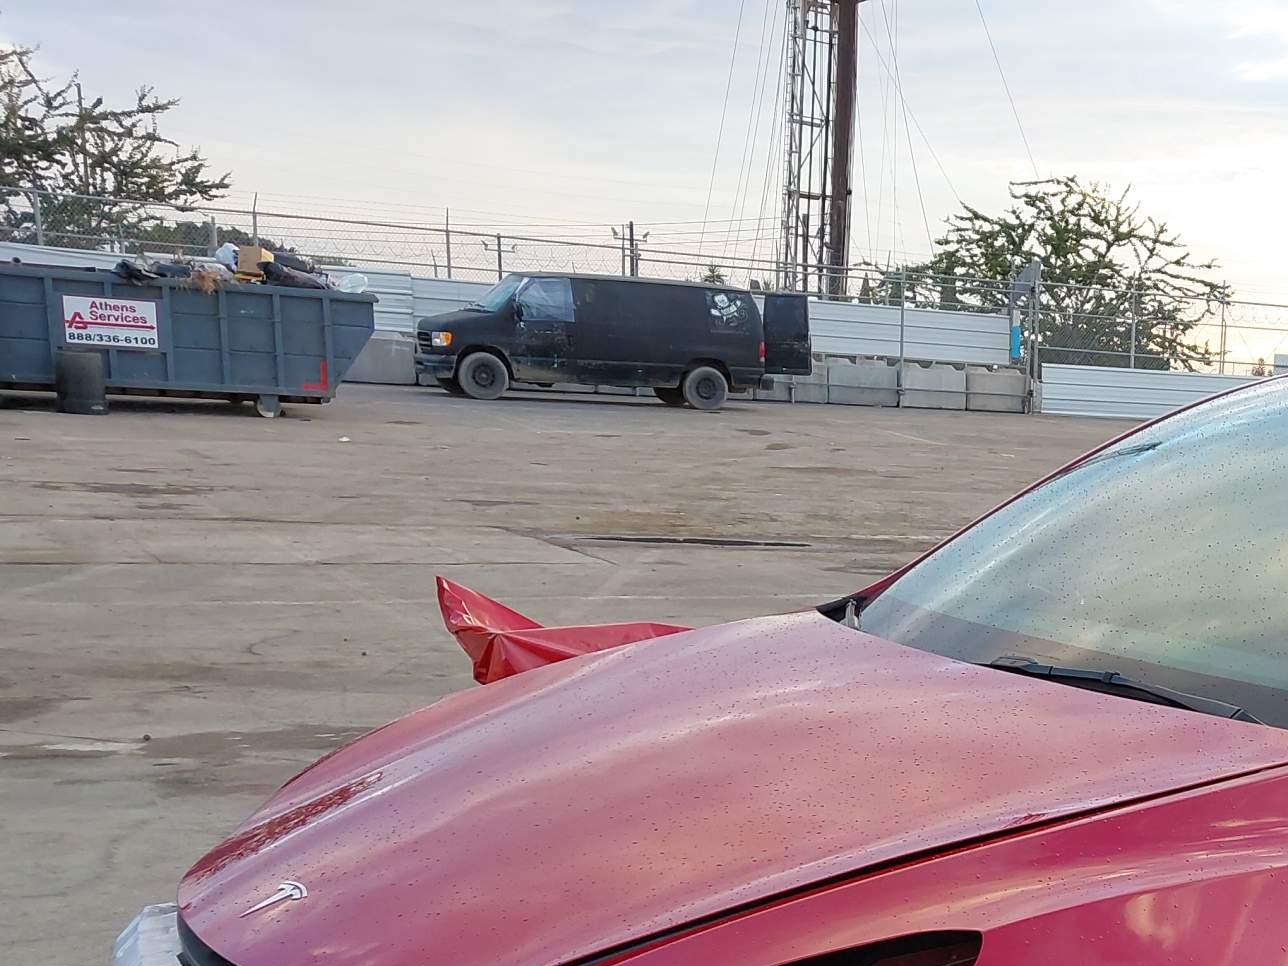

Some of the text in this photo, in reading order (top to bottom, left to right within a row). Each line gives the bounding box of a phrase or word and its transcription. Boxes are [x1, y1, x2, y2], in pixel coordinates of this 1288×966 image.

[89, 301, 137, 312] Athens
[89, 311, 147, 323] Services
[68, 332, 156, 345] 888/336-6100
